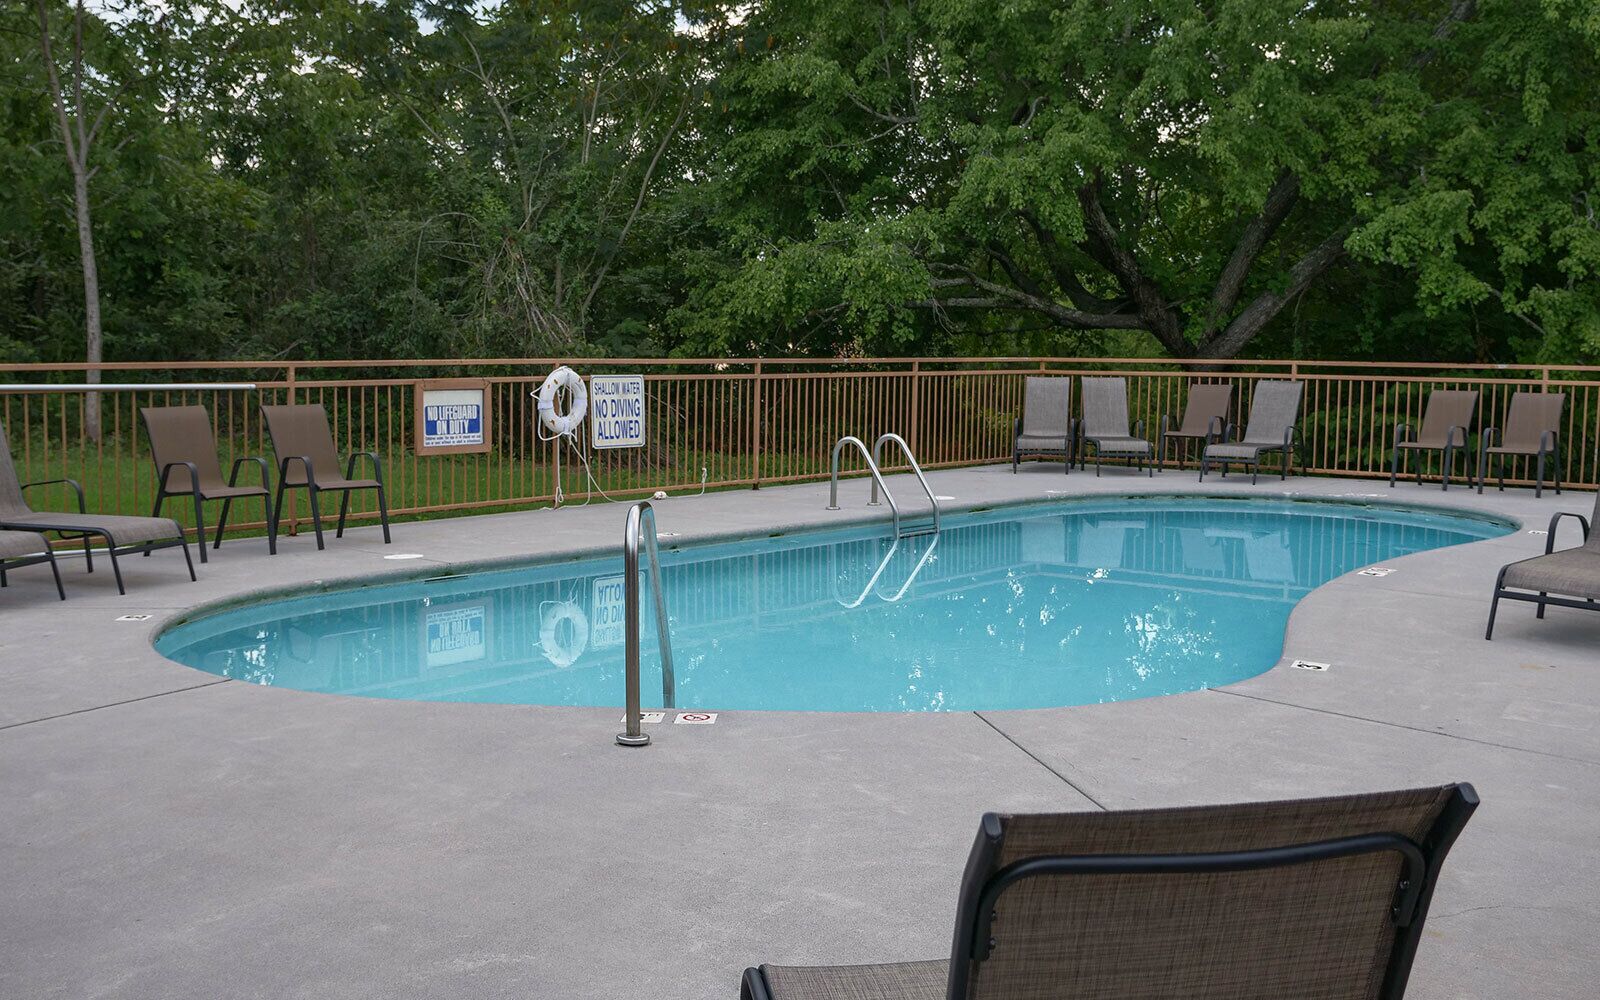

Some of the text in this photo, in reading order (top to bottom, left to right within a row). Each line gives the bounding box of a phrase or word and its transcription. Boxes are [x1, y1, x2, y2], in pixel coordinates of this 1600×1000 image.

[594, 382, 640, 395] SHALLOW WATER
[427, 405, 477, 421] NO LIFEGUARD
[595, 398, 640, 418] NO DIVING
[436, 419, 469, 435] ON DUTY
[597, 420, 640, 440] ALLOWED
